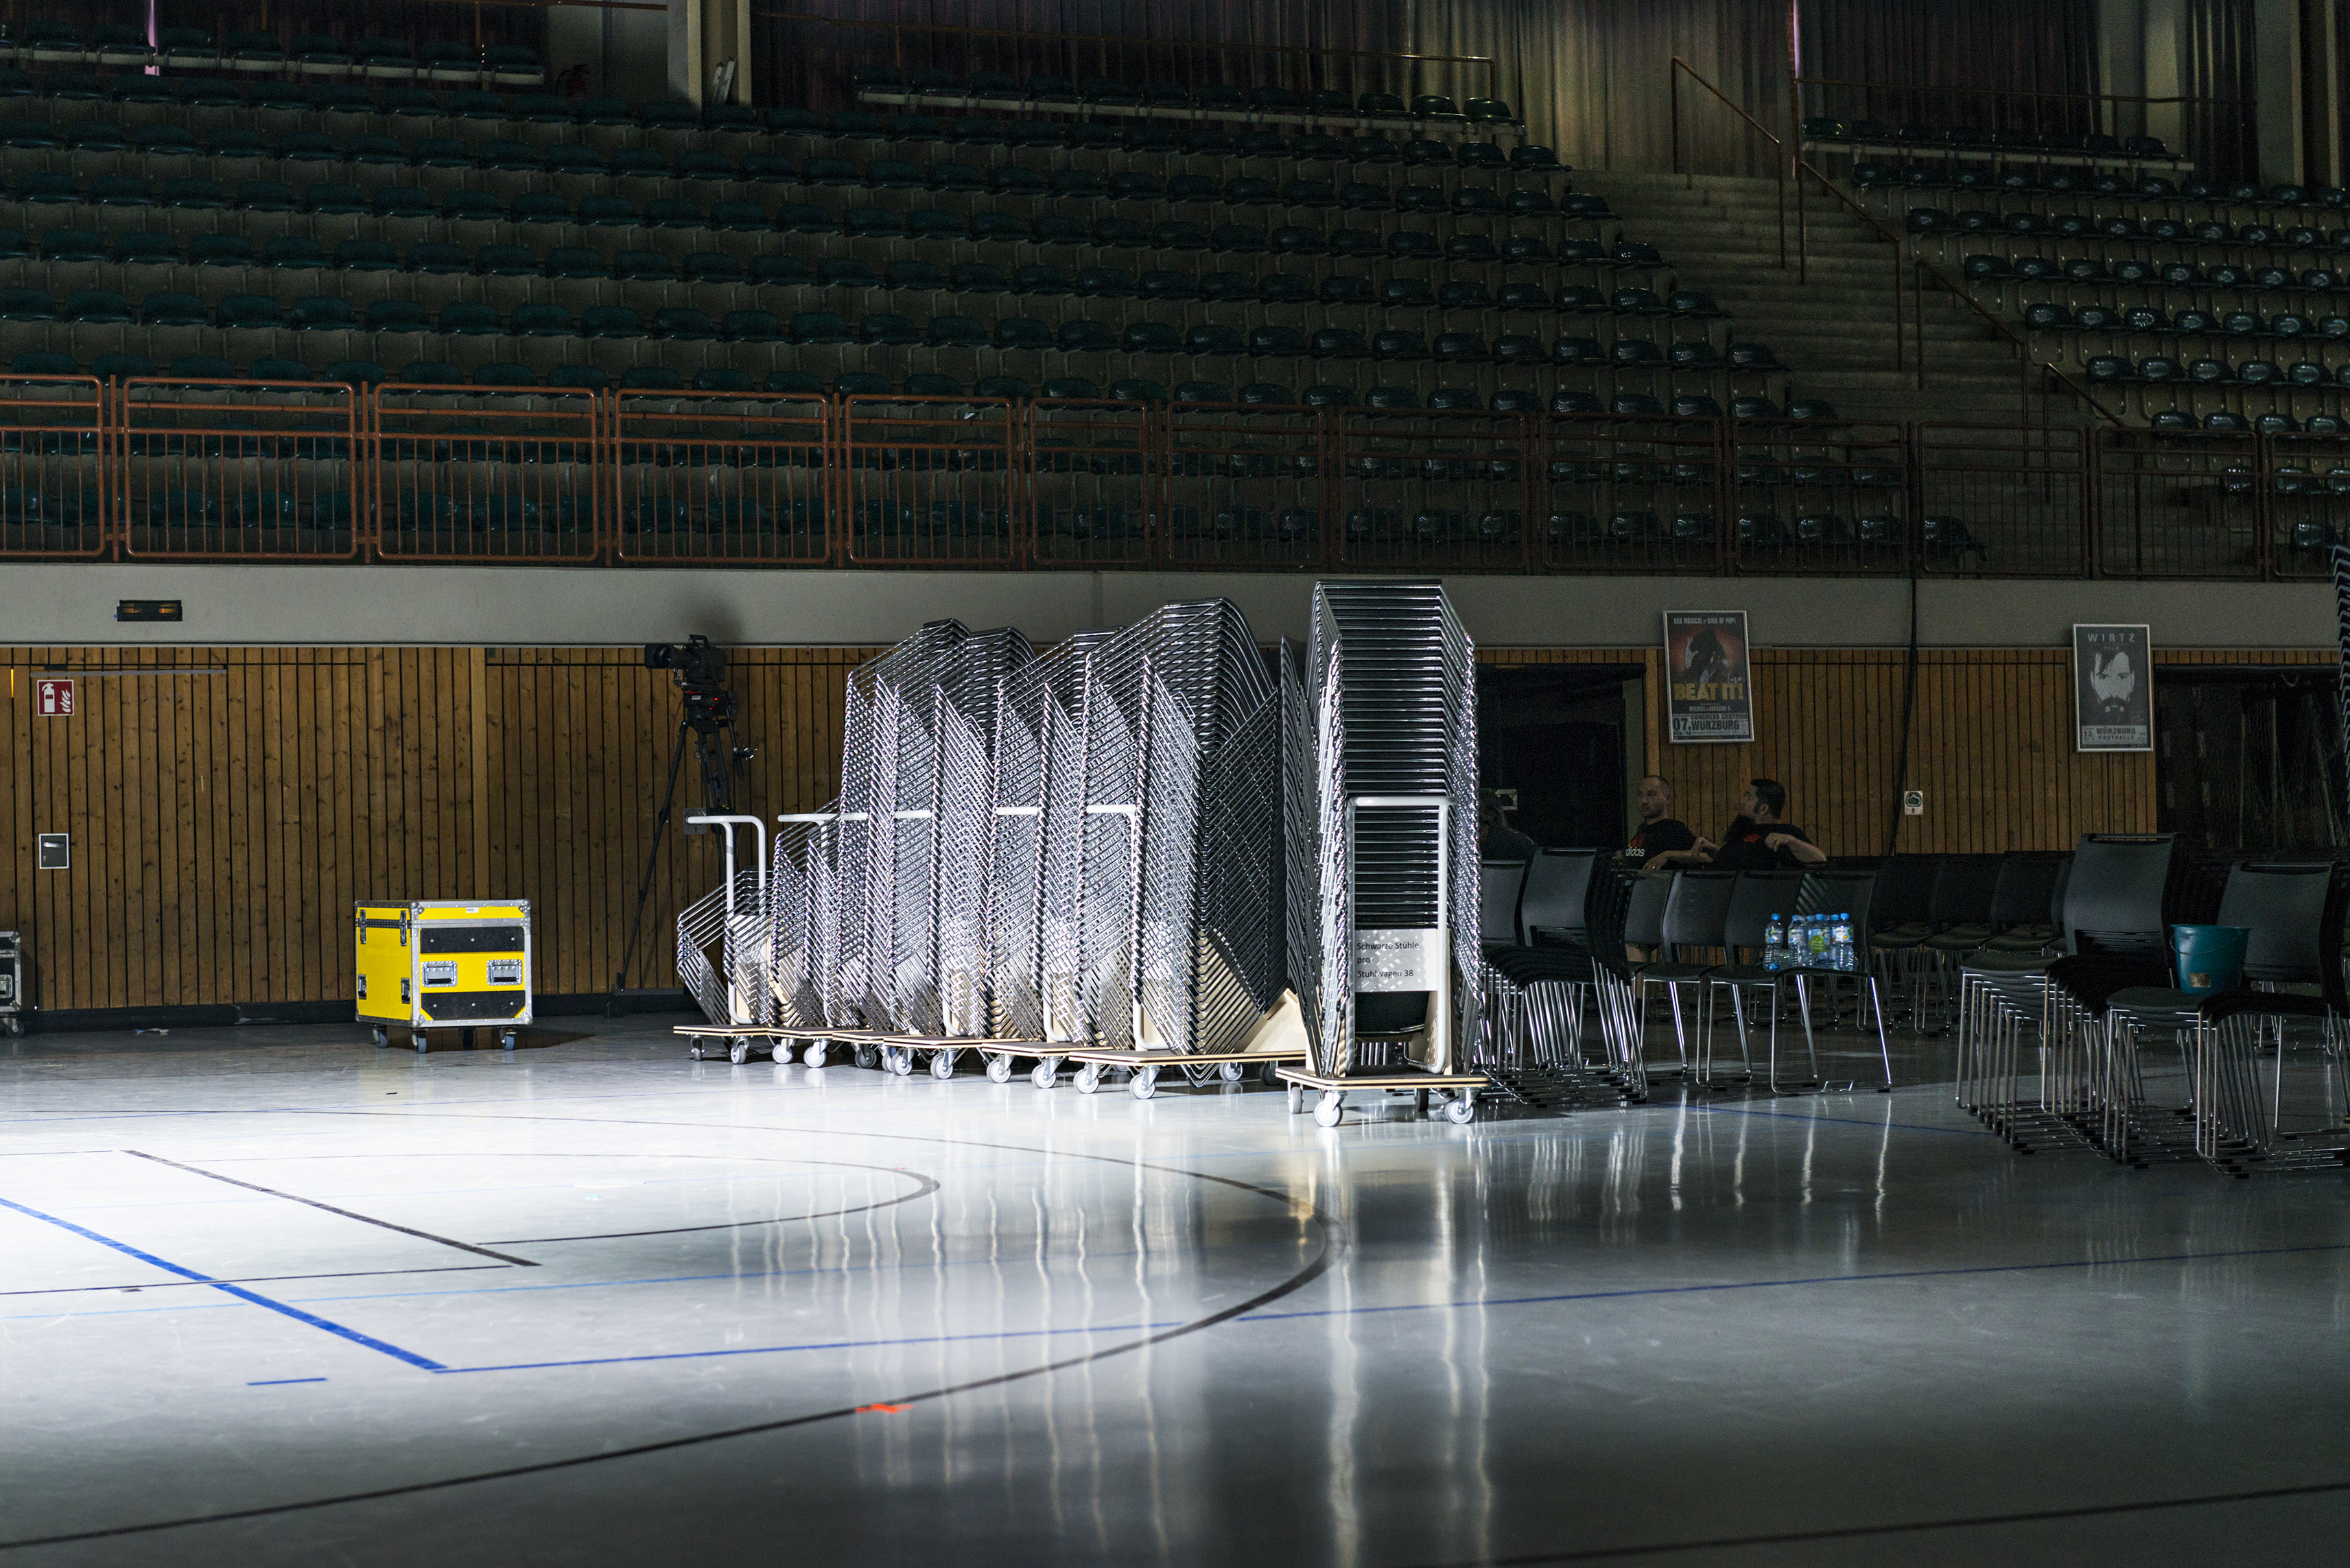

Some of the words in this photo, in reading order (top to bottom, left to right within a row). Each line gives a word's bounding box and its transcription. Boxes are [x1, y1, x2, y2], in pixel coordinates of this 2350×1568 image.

[2087, 633, 2135, 643] WIRTZ
[1673, 682, 1718, 700] BEAT
[1722, 682, 1743, 700] IT!
[2096, 726, 2136, 735] WÜRZBURG
[1625, 846, 1645, 857] didas
[1357, 970, 1402, 979] Stuhlwagen
[1404, 969, 1413, 977] 38
